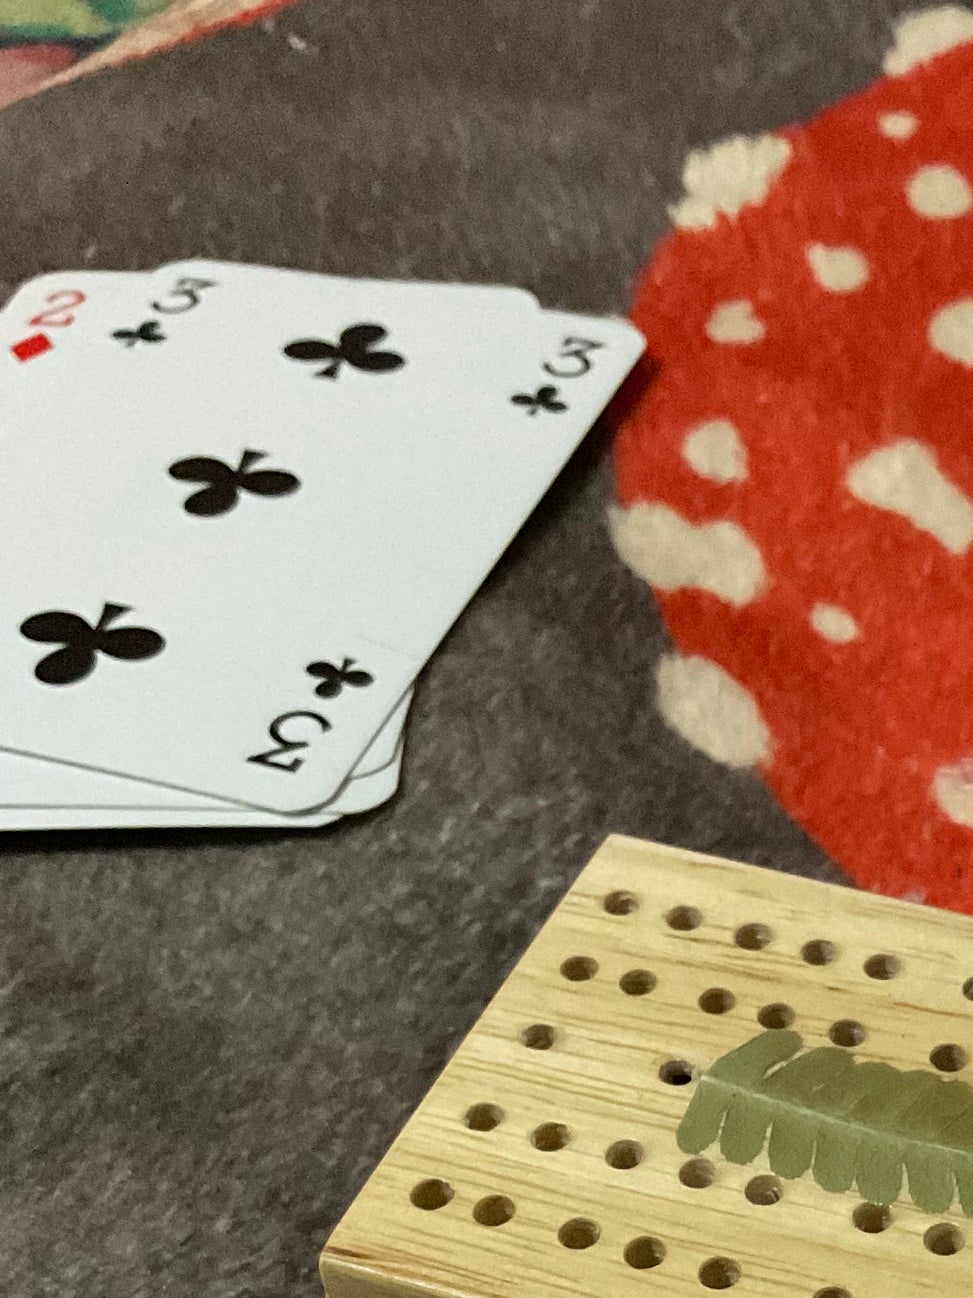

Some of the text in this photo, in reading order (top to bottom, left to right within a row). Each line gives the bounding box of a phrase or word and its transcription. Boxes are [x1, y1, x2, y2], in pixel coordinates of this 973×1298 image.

[27, 289, 87, 328] 2
[150, 276, 218, 315] 3
[541, 335, 606, 379] 3
[246, 709, 333, 774] 3
